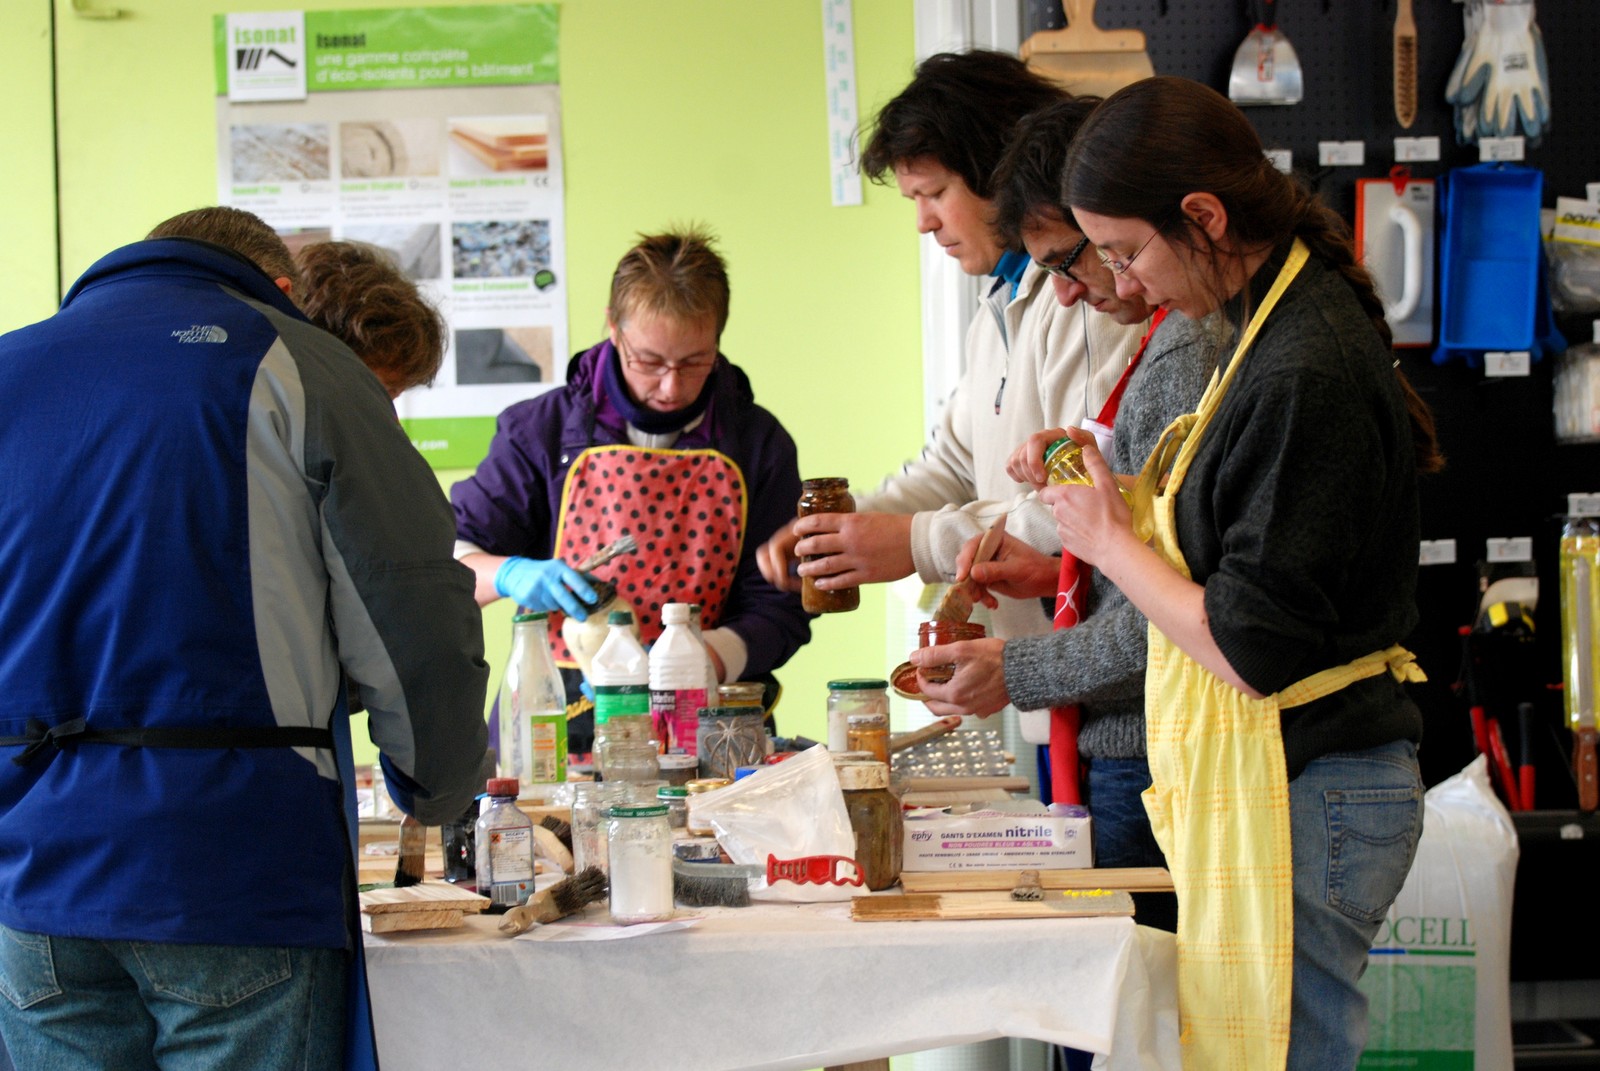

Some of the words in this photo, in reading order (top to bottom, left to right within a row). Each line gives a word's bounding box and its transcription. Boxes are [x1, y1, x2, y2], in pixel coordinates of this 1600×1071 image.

[235, 26, 297, 44] isonat
[315, 54, 343, 66] une
[346, 52, 399, 68] gamme
[418, 66, 452, 80] pour
[455, 65, 469, 77] le
[471, 63, 534, 78] bâtiment
[911, 831, 933, 842] ephy
[1005, 826, 1053, 838] nitrile
